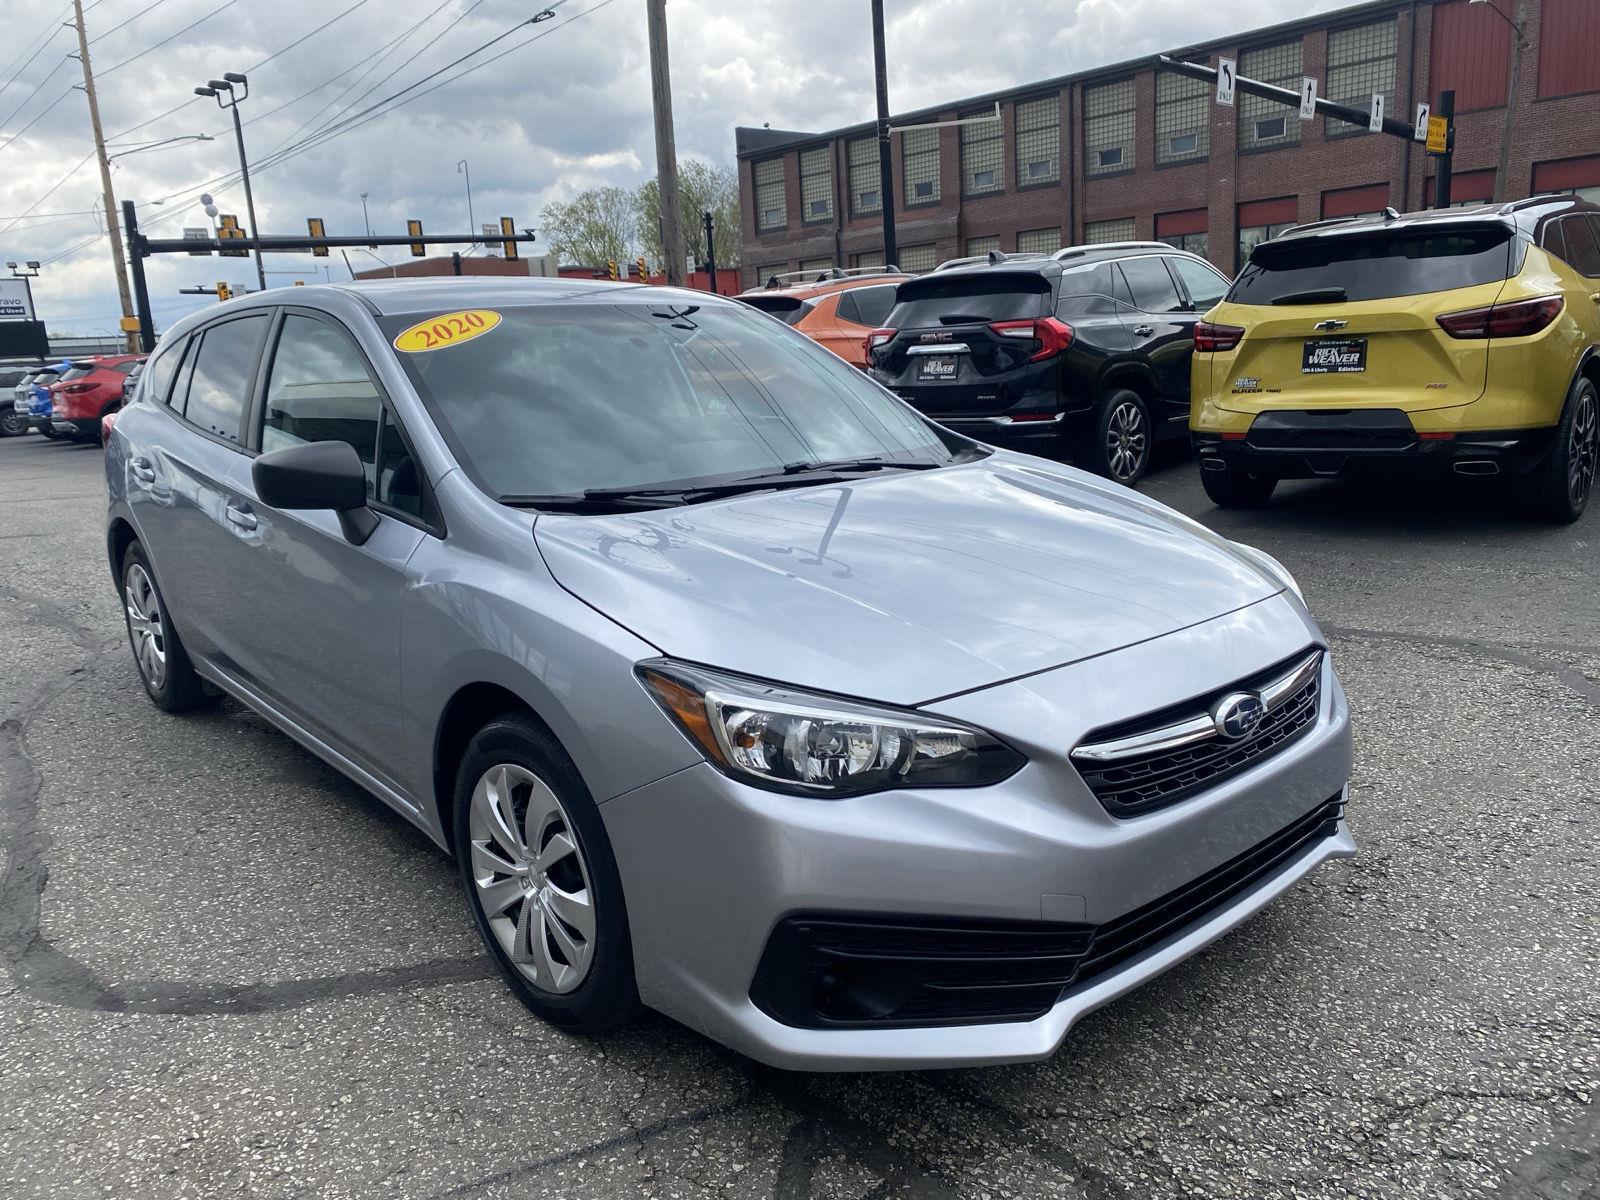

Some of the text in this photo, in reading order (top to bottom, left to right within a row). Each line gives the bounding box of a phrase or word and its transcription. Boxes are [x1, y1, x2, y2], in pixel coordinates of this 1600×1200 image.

[1219, 91, 1233, 102] ONLY
[1302, 105, 1314, 115] ONLY
[1371, 118, 1381, 128] ONLY
[1416, 127, 1426, 137] ONLY
[415, 312, 485, 348] 2020
[920, 332, 953, 343] GMC
[1314, 347, 1340, 357] RICK
[1308, 353, 1360, 364] WEAVER
[923, 364, 955, 374] WEAVER
